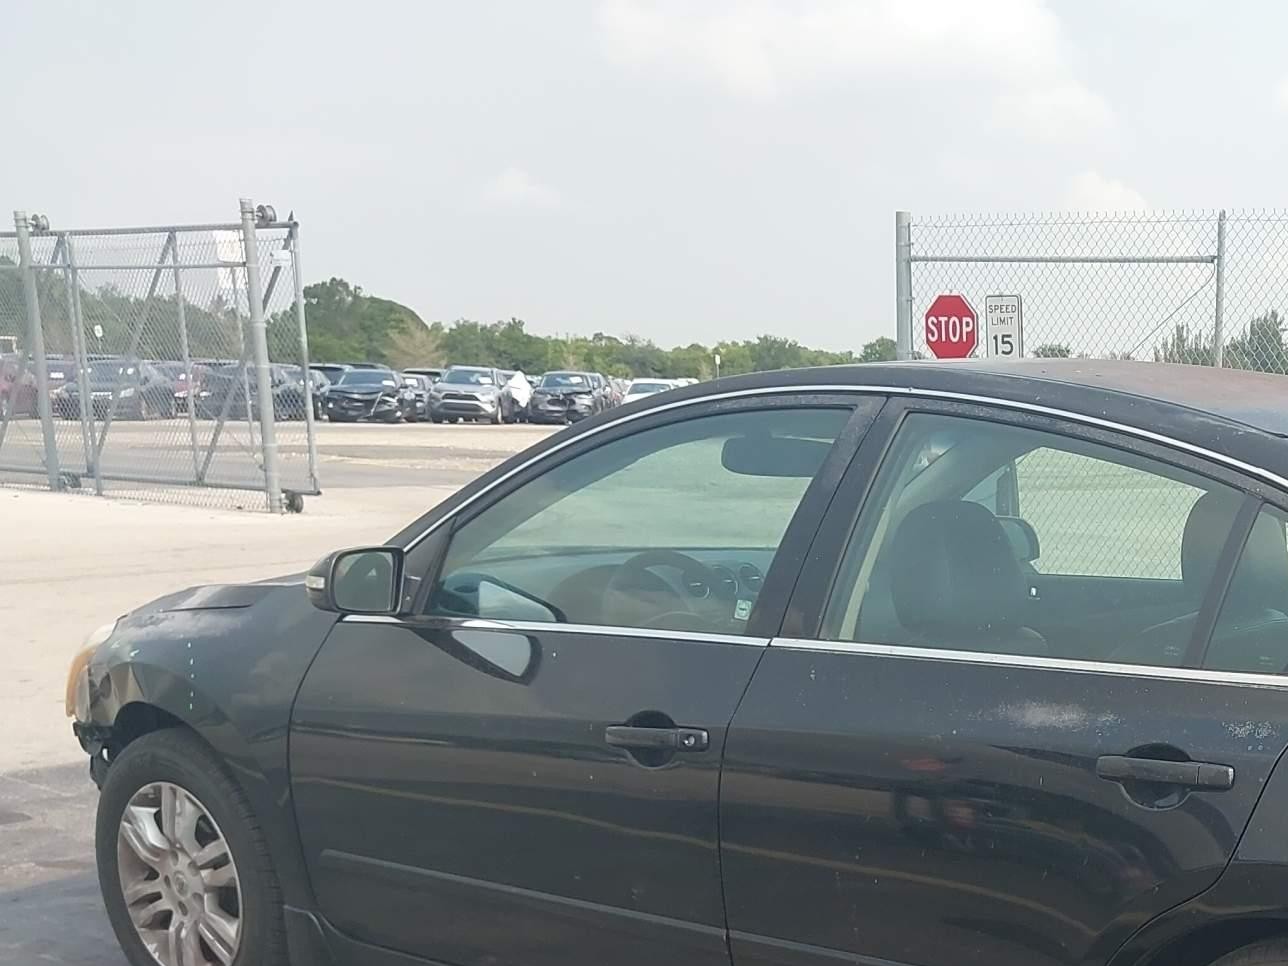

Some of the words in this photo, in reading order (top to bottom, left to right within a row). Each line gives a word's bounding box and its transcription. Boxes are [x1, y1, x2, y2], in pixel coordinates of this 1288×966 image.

[988, 304, 1017, 314] SPEED
[991, 316, 1014, 326] LIMIT
[927, 316, 973, 342] STOP
[993, 334, 1014, 355] 15
